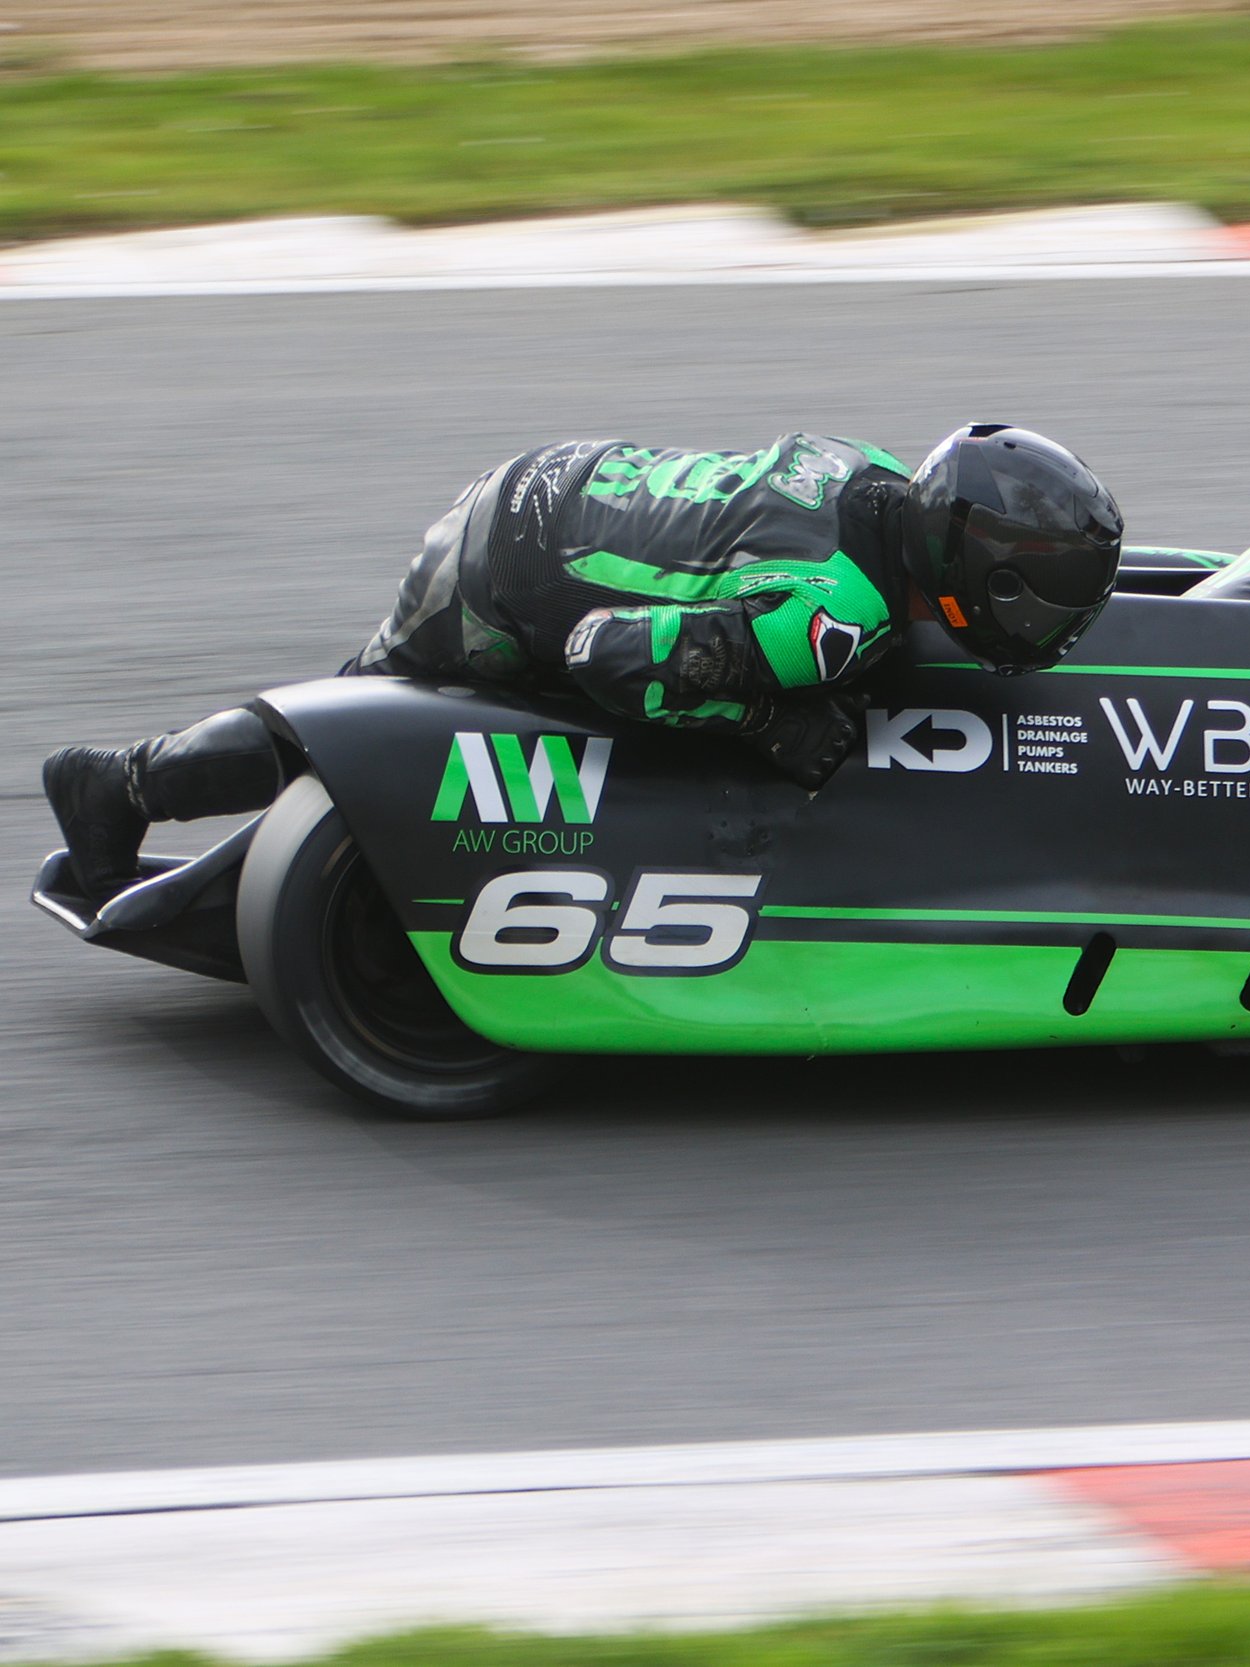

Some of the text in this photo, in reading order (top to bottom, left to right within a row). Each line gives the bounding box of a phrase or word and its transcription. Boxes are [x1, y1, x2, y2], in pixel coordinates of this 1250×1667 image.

[1016, 714, 1083, 728] ASBESTOS
[1016, 730, 1089, 744] DRAINAGE
[1017, 745, 1065, 759] PUMPS
[1016, 761, 1079, 775] TANKERS
[430, 731, 614, 824] AW
[452, 829, 595, 855] AW GROUP
[459, 870, 763, 967] 65
